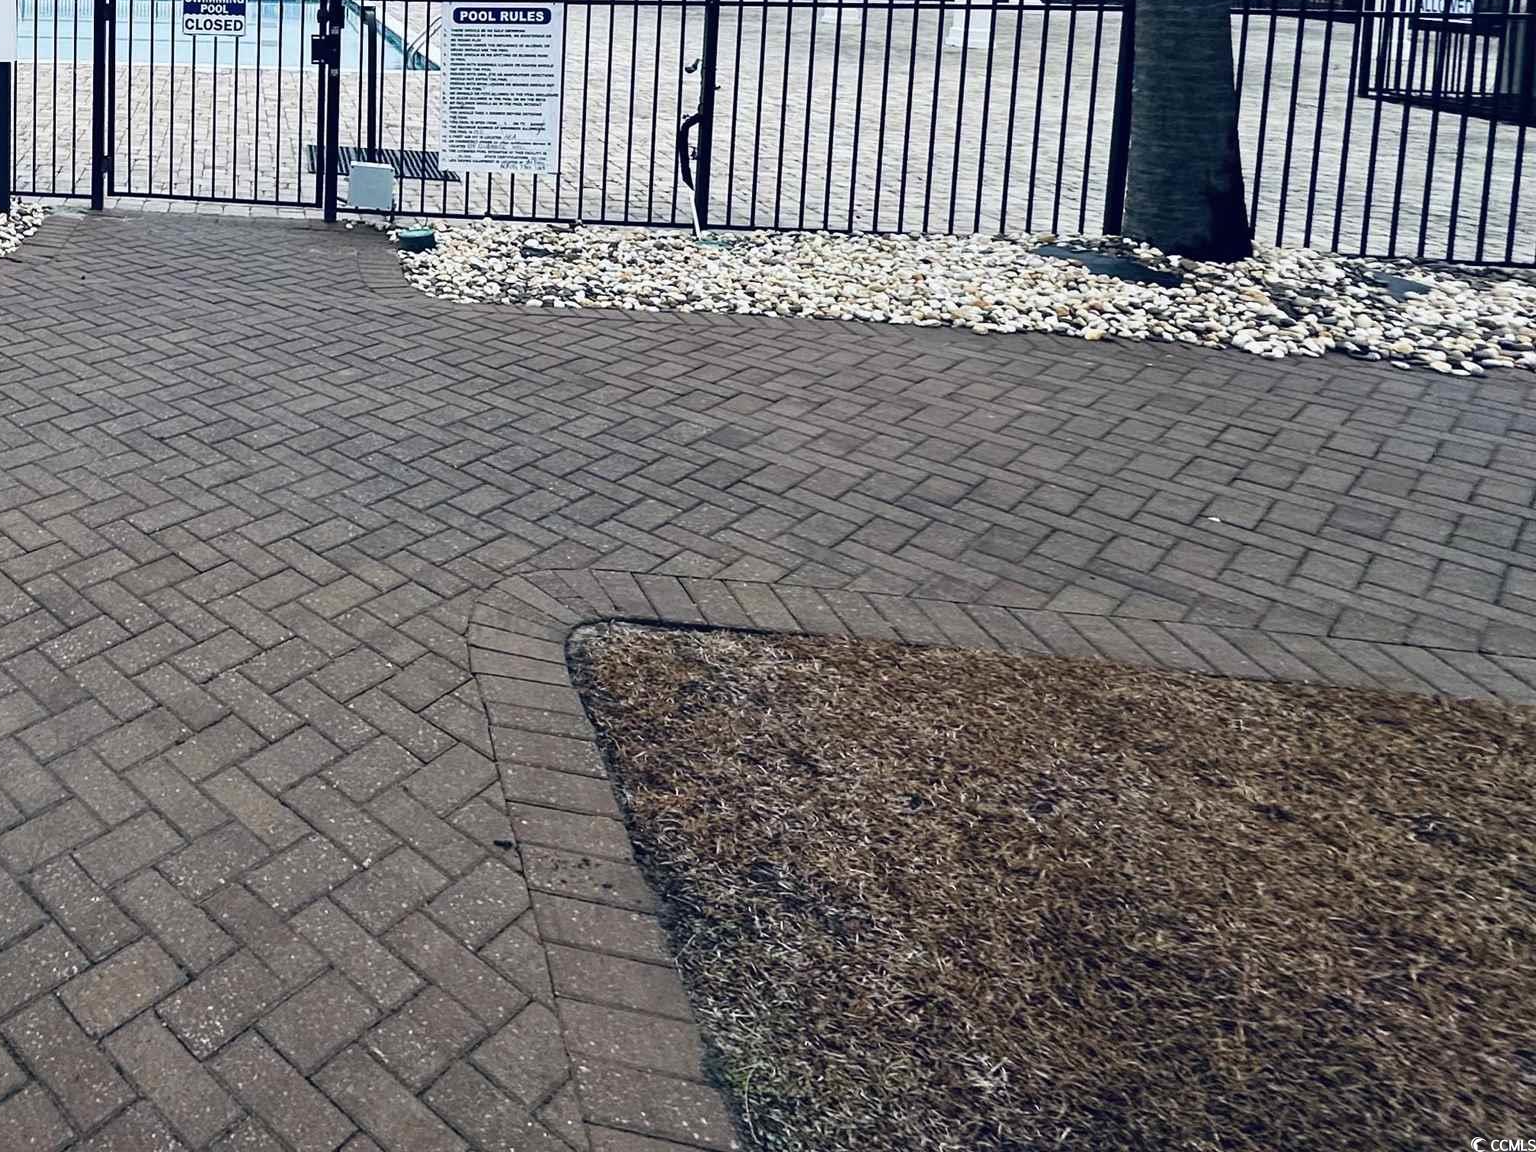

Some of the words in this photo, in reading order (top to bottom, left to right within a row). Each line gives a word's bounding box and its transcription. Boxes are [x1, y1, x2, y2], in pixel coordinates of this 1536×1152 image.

[200, 4, 229, 14] POOL
[459, 11, 496, 22] POOL
[500, 11, 545, 22] RULES
[184, 18, 243, 32] CLOSED
